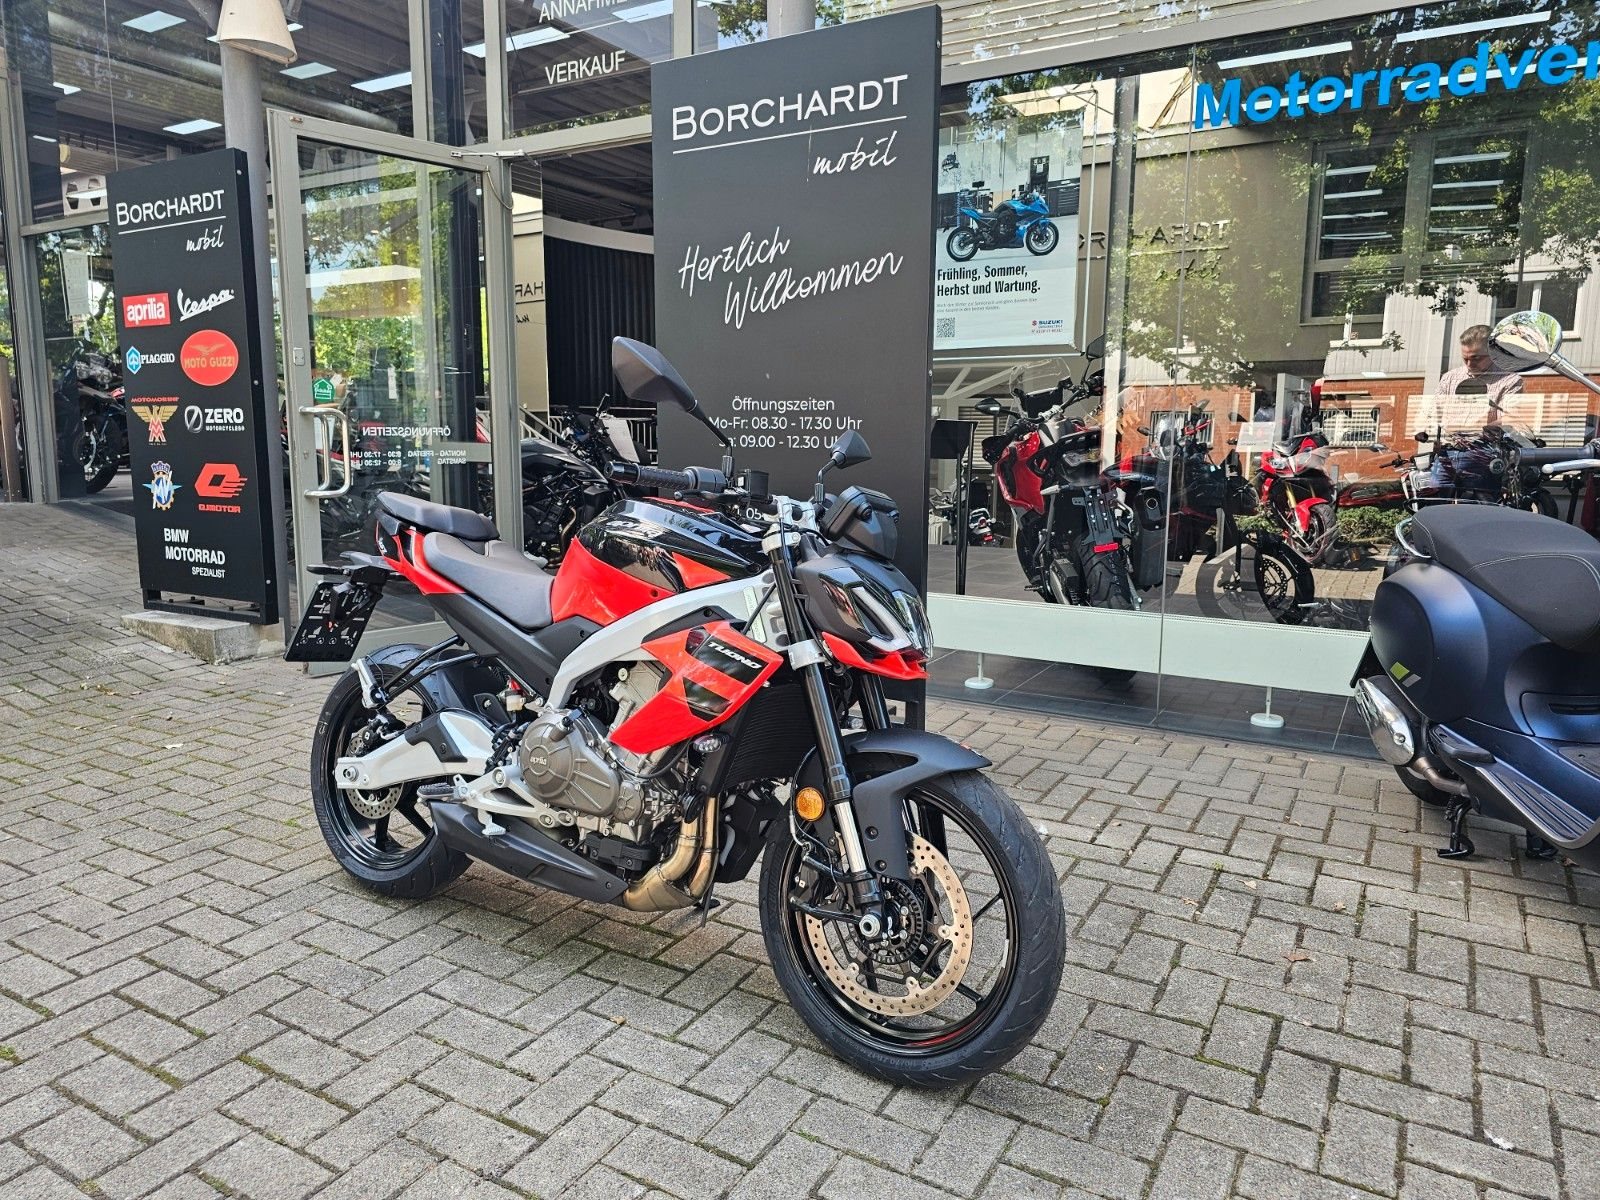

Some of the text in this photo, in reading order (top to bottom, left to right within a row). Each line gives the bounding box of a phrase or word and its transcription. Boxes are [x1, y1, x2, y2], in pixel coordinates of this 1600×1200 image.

[545, 50, 626, 85] VERKAUF
[672, 74, 908, 141] BORCHARDT
[812, 130, 898, 175] mobil
[116, 189, 225, 226] BORCHARDT
[186, 225, 224, 251] mobil
[678, 226, 790, 297] Herzlich
[937, 265, 1028, 281] Frühling, Sommer,
[724, 252, 903, 329] Willkommen
[937, 279, 1041, 297] Herbst und Wartung.
[126, 297, 166, 325] aprilia
[177, 288, 232, 321] Vespa
[141, 353, 176, 365] PIAGGIO
[184, 356, 236, 369] MOTO GUZZI
[731, 396, 835, 414] Öffnungszeiten
[204, 407, 244, 424] ZERO
[708, 416, 749, 430] Mo-Fr:
[751, 416, 788, 430] 08.30
[799, 416, 832, 430] 17.30
[836, 416, 863, 430] Uhr
[739, 435, 776, 448] 09.00
[787, 435, 820, 449] 12.30
[163, 528, 189, 543] BMW
[165, 545, 226, 565] MOTORRAD
[191, 566, 226, 579] SPEZIALIST
